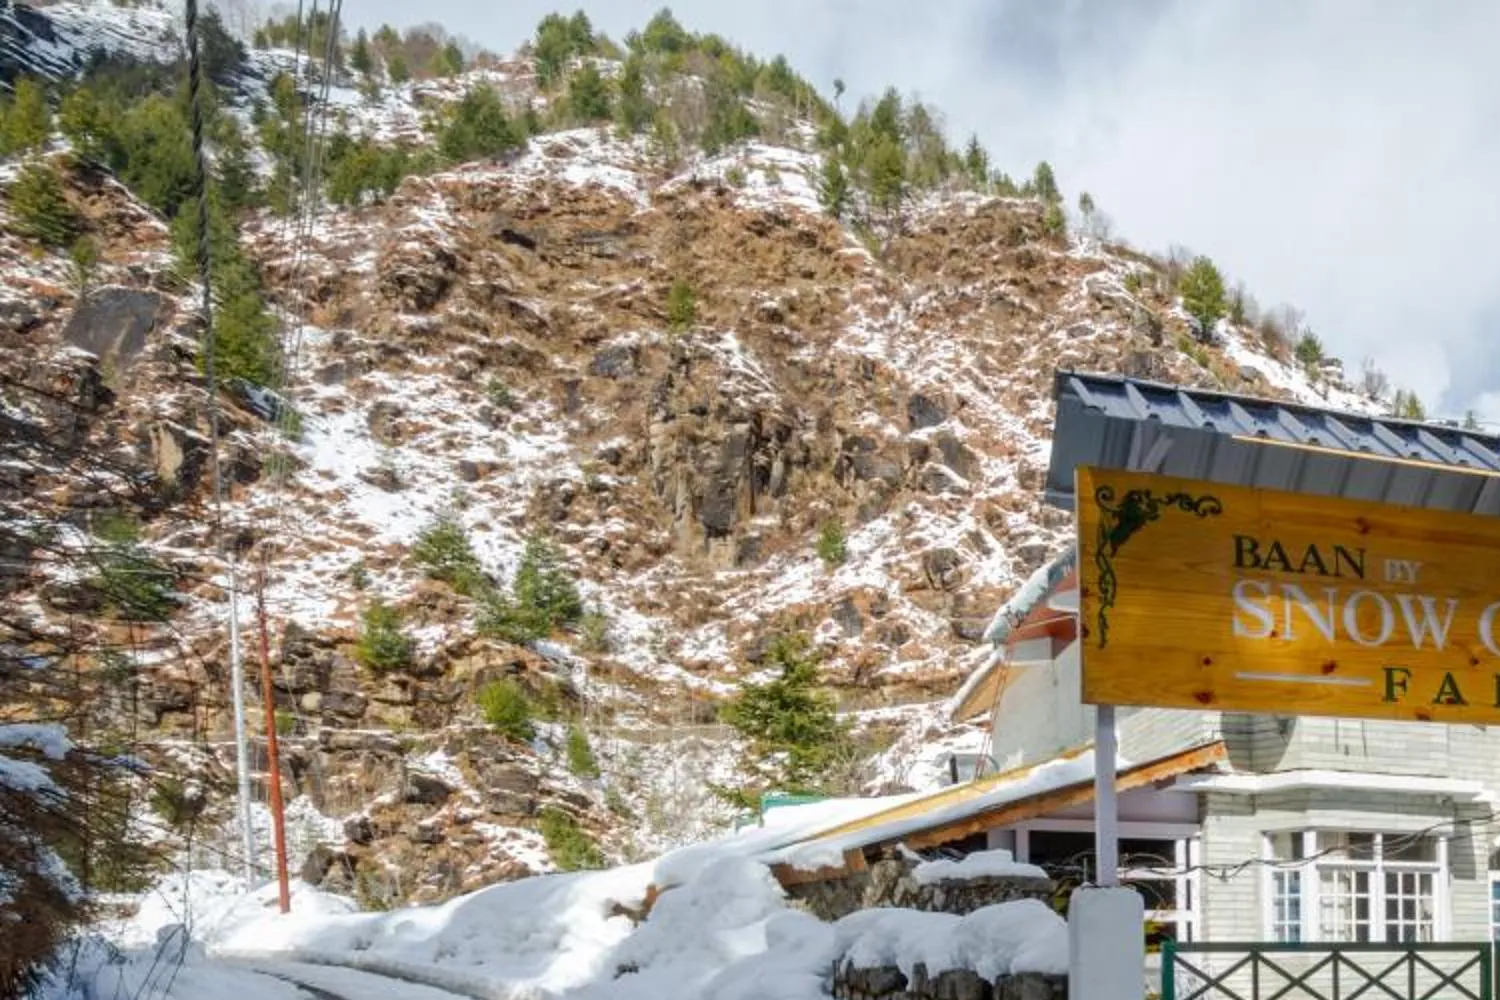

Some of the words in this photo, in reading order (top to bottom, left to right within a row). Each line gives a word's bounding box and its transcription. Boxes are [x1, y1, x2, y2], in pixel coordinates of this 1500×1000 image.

[1232, 534, 1367, 580] BAAN
[1384, 558, 1423, 585] BY
[1232, 578, 1459, 652] SNOW
